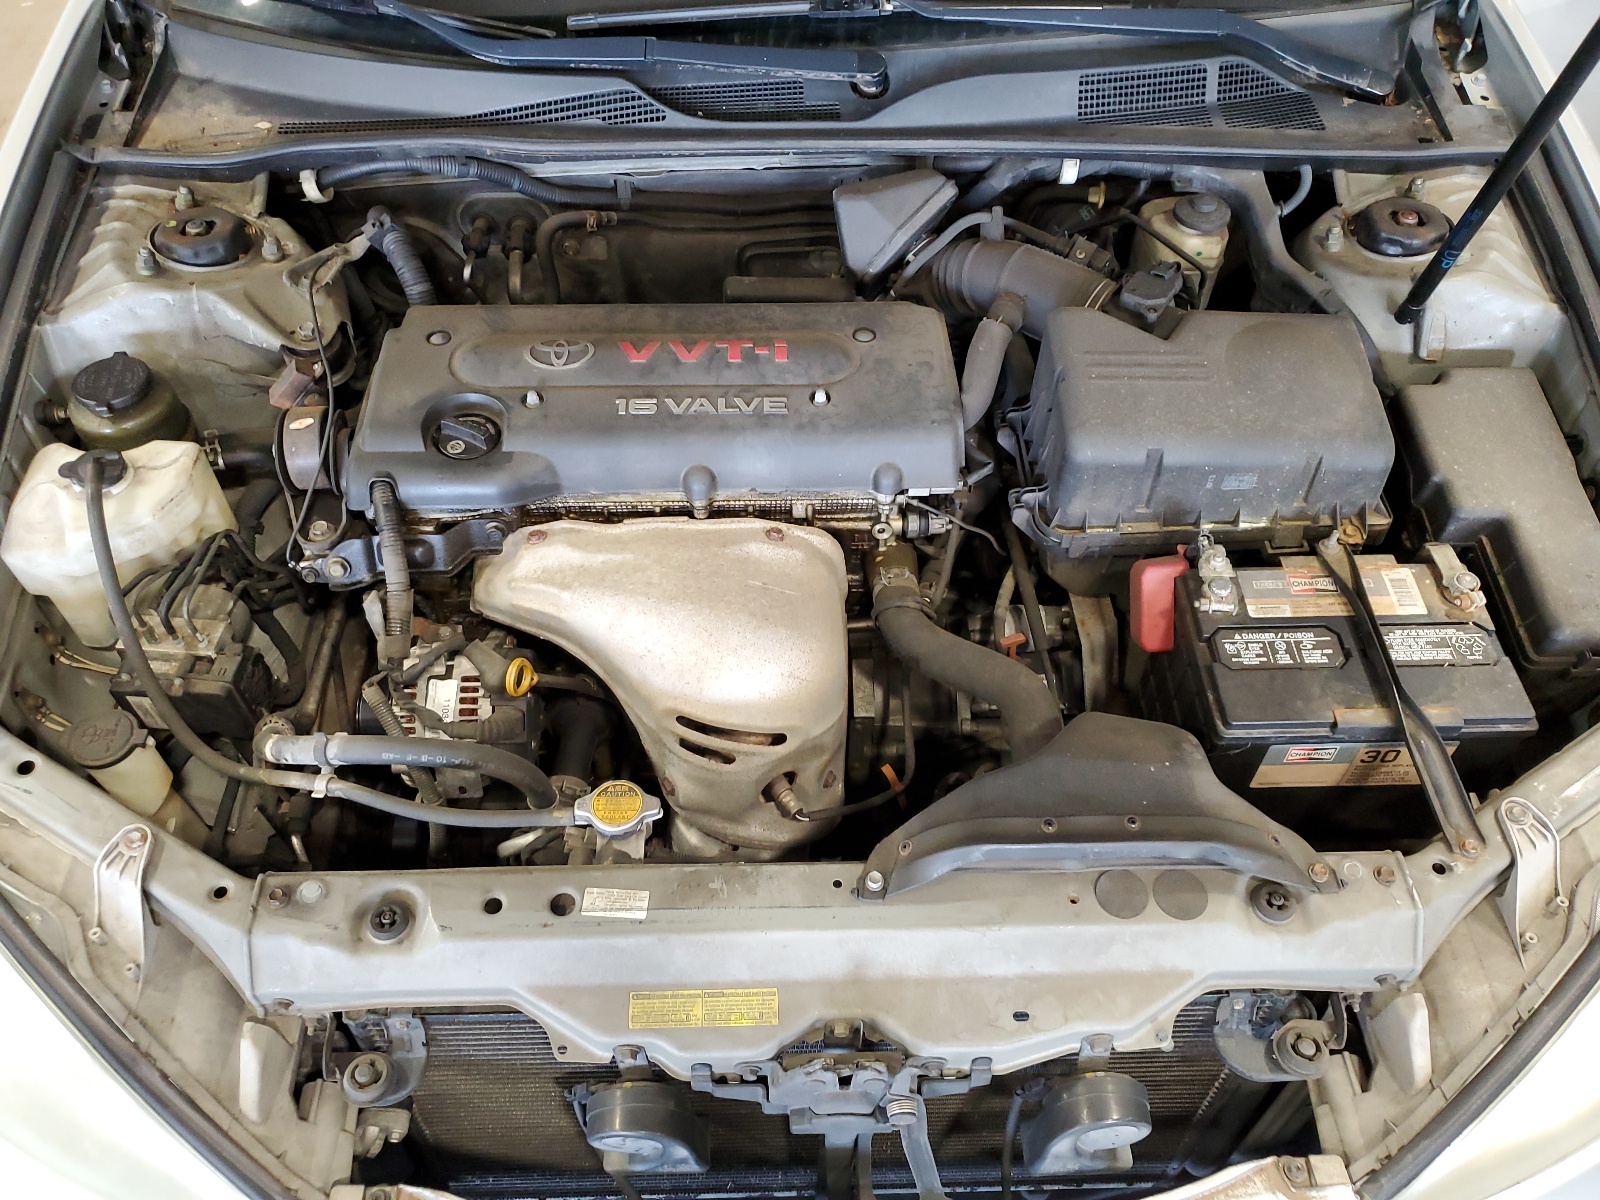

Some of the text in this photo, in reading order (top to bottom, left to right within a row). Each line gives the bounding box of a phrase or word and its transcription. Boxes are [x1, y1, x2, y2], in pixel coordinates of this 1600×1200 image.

[615, 397, 789, 415] 16 VALVE
[1292, 579, 1335, 588] CHAMPION
[1242, 632, 1276, 640] DANGER
[1283, 631, 1314, 639] POISON
[1290, 750, 1333, 758] CHAMPION
[1359, 750, 1402, 764] 30
